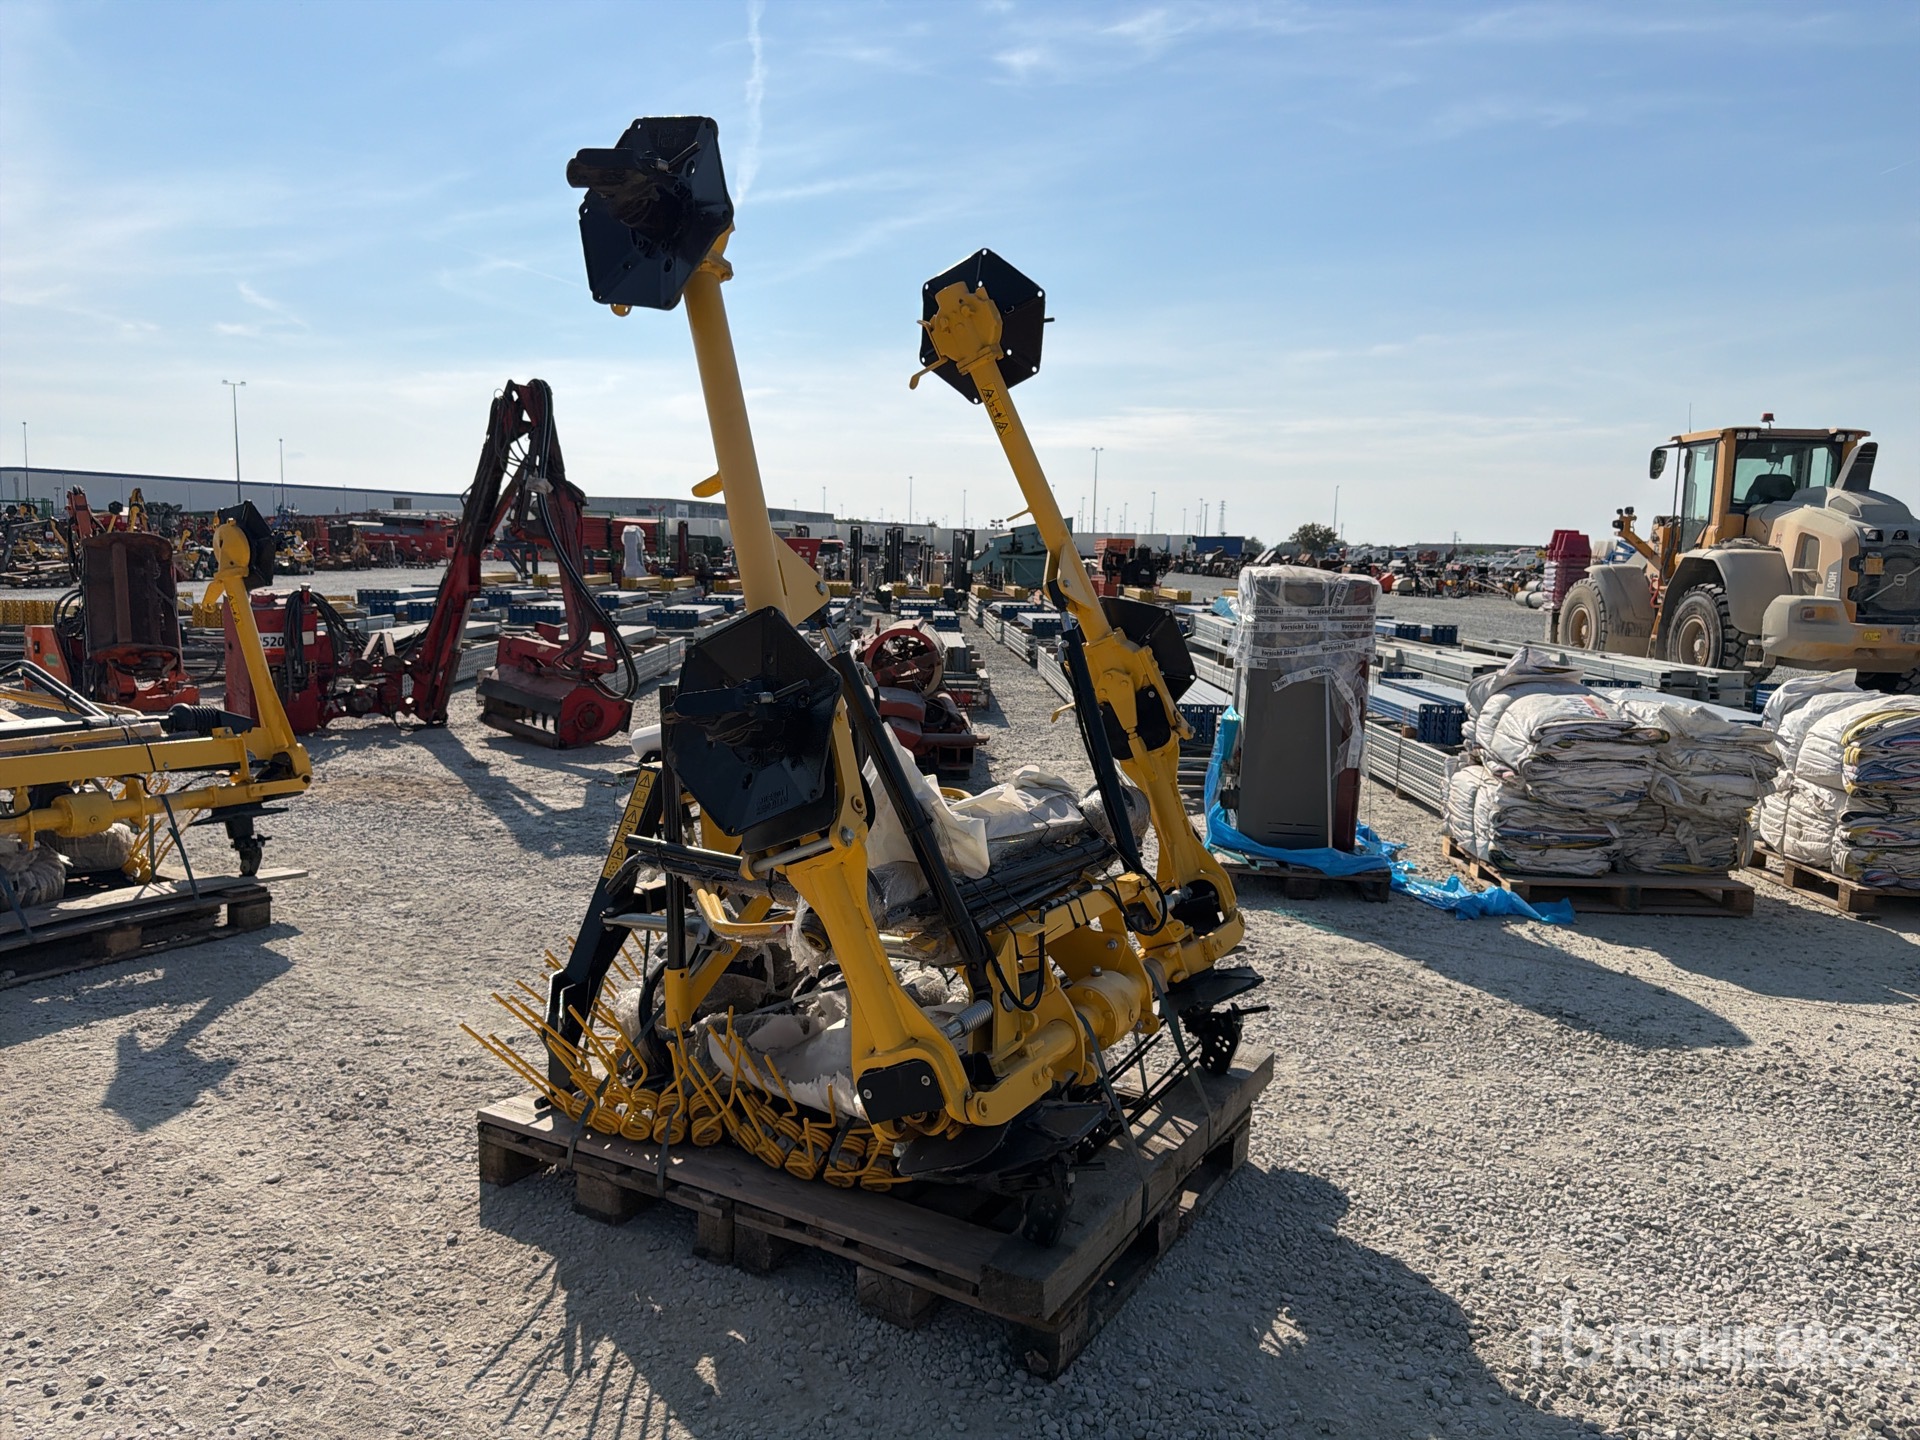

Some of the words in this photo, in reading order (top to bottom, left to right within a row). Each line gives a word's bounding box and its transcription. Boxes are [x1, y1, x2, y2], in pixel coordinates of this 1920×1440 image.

[1827, 571, 1837, 593] L90H
[1308, 607, 1331, 615] Vorsicht
[260, 636, 284, 647] 520
